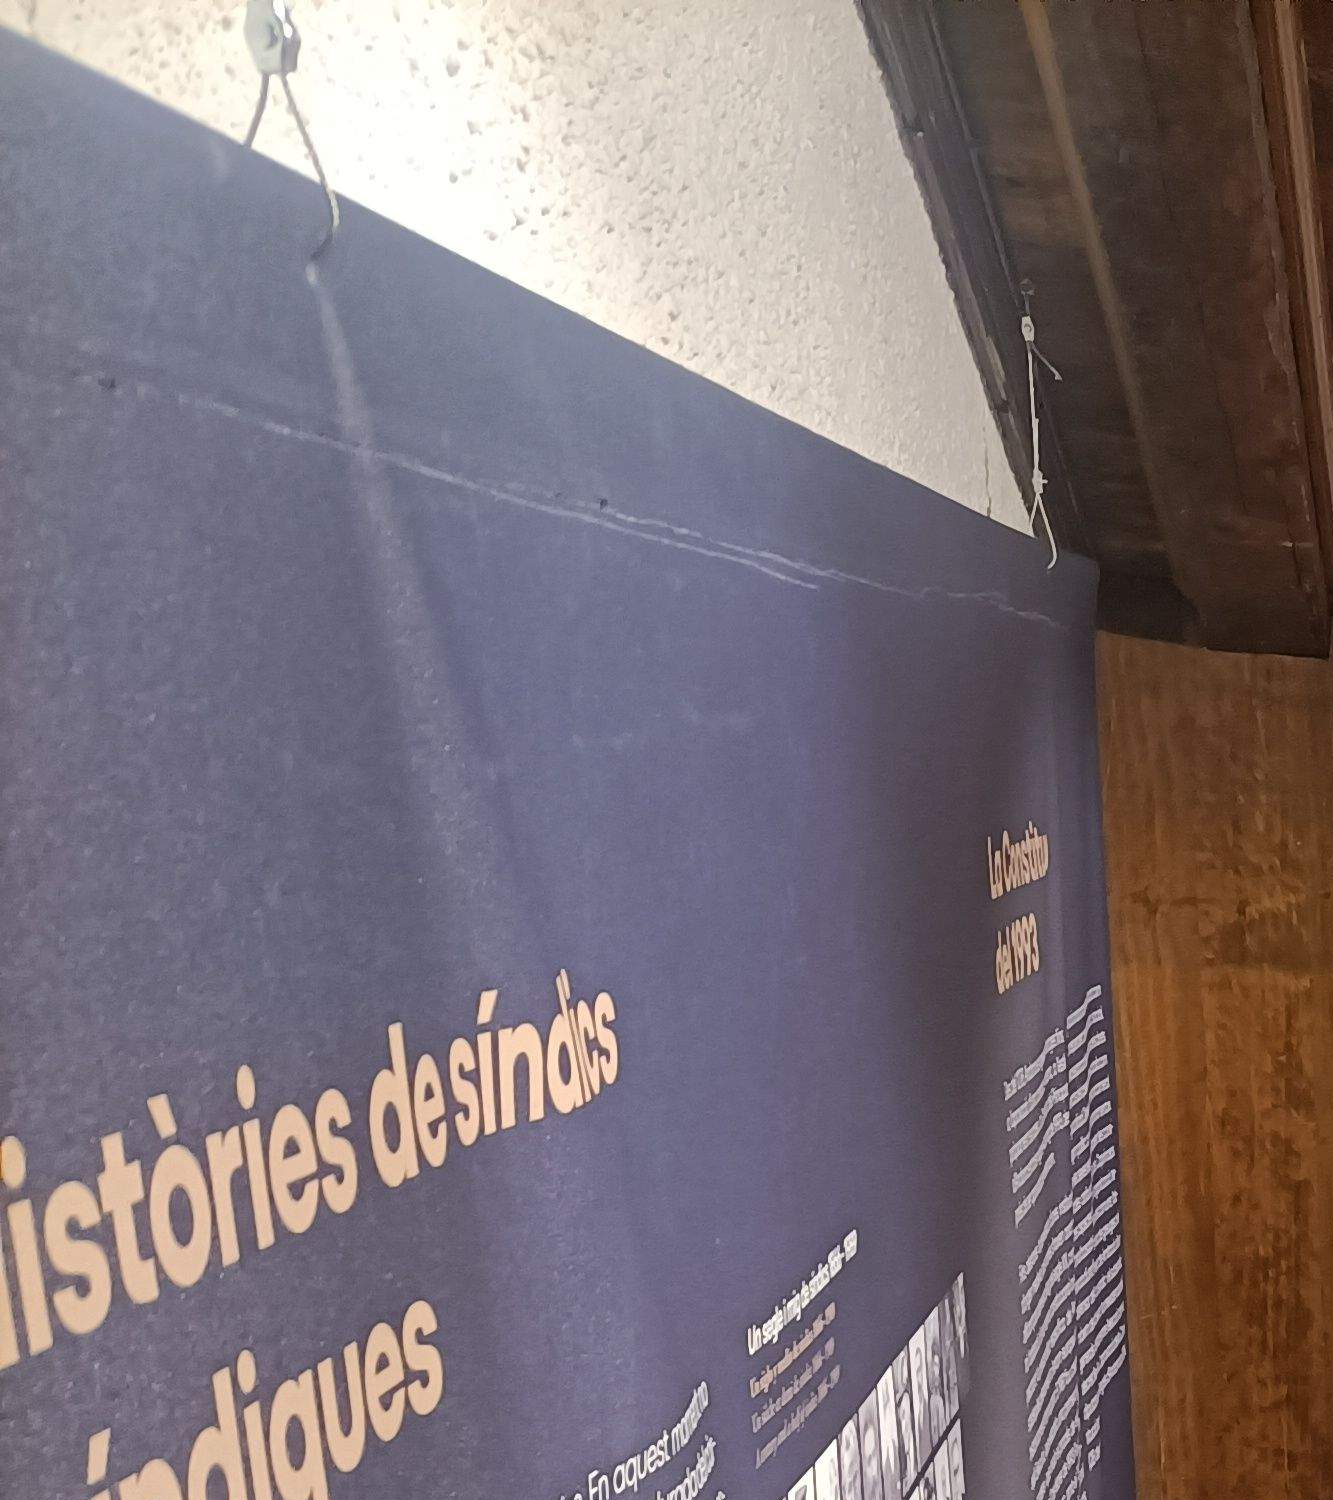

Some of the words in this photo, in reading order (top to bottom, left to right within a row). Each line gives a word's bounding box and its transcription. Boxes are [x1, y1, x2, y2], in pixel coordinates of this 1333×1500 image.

[988, 836, 1003, 900] La
[369, 1022, 448, 1188] de
[449, 968, 619, 1147] síndics
[613, 1430, 670, 1493] aquest
